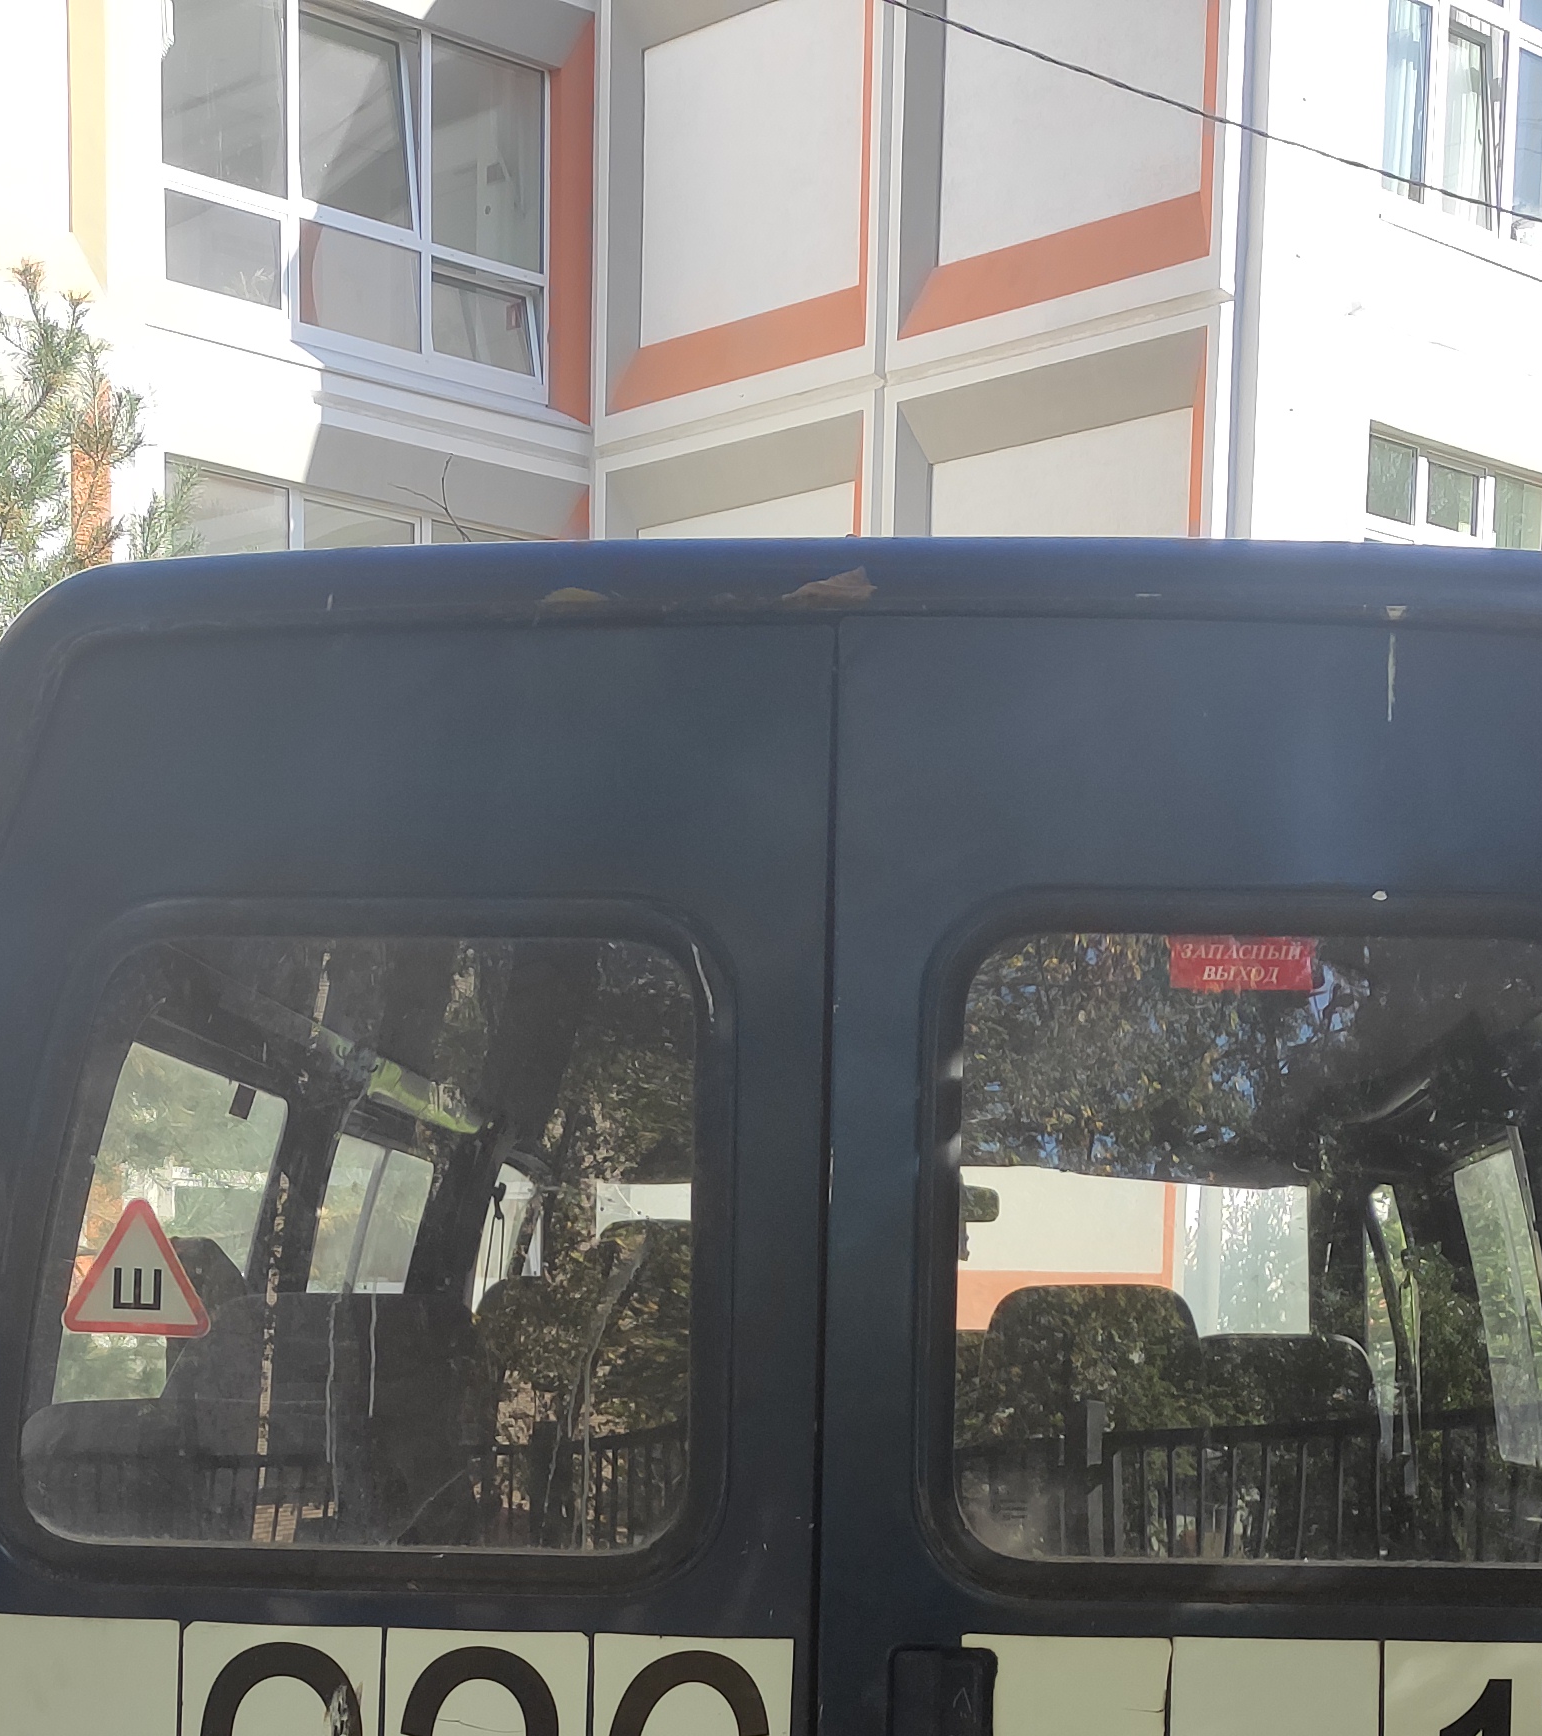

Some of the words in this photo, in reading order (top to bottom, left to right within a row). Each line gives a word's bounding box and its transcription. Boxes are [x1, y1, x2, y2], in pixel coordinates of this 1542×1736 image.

[1180, 941, 1304, 961] ЗАПАСНЫЙ
[1202, 965, 1280, 984] ВЫХОД
[112, 1267, 162, 1310] Ш
